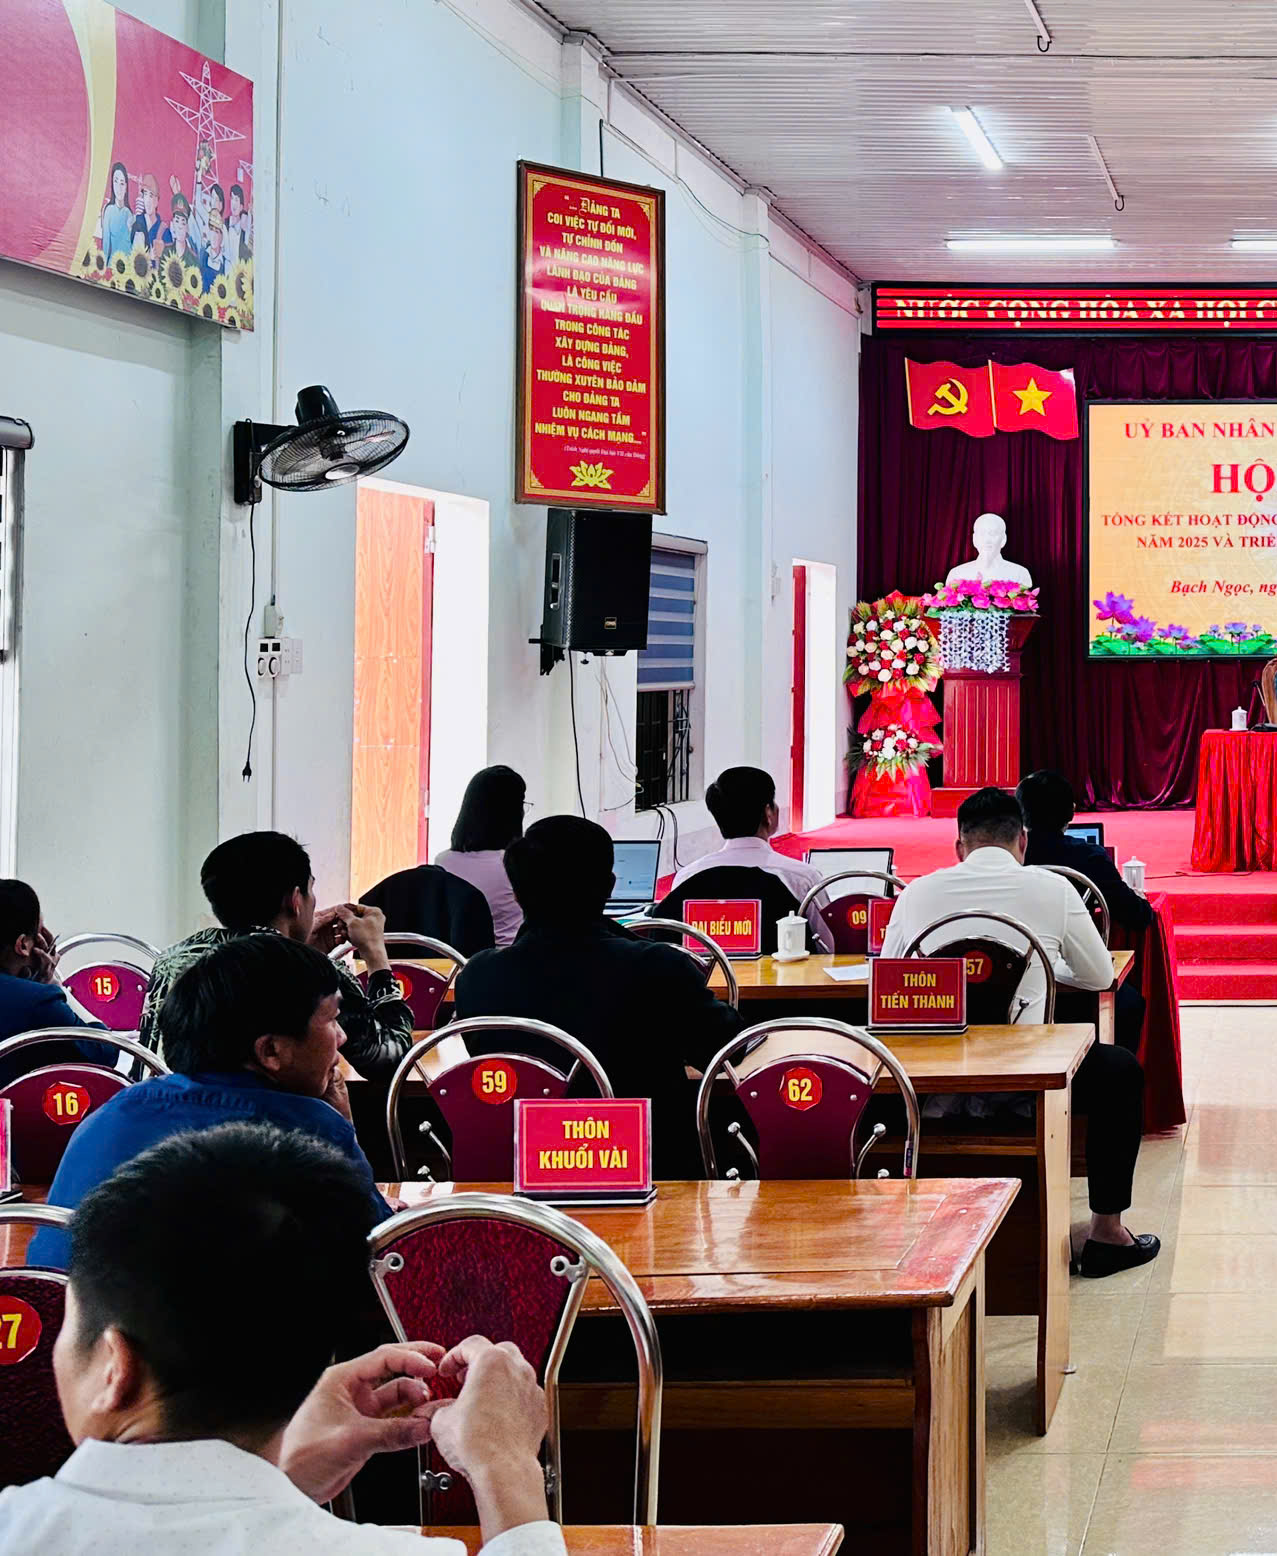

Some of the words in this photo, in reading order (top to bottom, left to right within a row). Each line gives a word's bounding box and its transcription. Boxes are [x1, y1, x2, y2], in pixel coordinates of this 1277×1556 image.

[579, 197, 608, 217] ĐẢNG
[611, 207, 620, 219] TA
[547, 212, 562, 225] COI
[565, 215, 585, 230] VIỆC
[587, 220, 599, 234] TỰ
[600, 221, 615, 235] ĐỔI
[617, 226, 637, 240] MỚI,
[562, 232, 574, 246] TỰ
[575, 234, 602, 249] CHỈNH
[605, 240, 623, 253] ĐỐN
[554, 319, 584, 334] TRONG
[587, 322, 611, 338] CÔNG
[613, 326, 630, 340] TÁC
[555, 336, 573, 349] XÂY
[575, 340, 600, 354] DỰNG
[602, 341, 629, 358] ĐẢNG,
[562, 354, 573, 367] LÀ
[575, 356, 600, 371] CÔNG
[602, 361, 622, 375] VIỆC
[536, 369, 572, 384] THƯỜNG
[575, 374, 604, 389] XUYÊN
[606, 376, 624, 391] BẢO
[626, 379, 646, 394] ĐẢM
[563, 390, 581, 403] CHO
[583, 390, 608, 406] ĐẢNG
[610, 396, 620, 408] TA
[552, 406, 576, 421] LUÔN
[578, 410, 609, 424] NGANG
[612, 411, 631, 426] TẦM
[535, 422, 565, 438] NHIỆM
[567, 426, 579, 440] VỤ
[581, 426, 605, 440] CÁCH
[1162, 422, 1206, 438] BAN
[1212, 417, 1275, 438] NHÂN
[1102, 511, 1146, 527] TỔNG
[1152, 511, 1184, 526] KẾT
[1188, 514, 1233, 528] HOẠT
[1136, 534, 1173, 549] NĂM
[1177, 536, 1209, 549] 2025
[1212, 533, 1234, 548] VÀ
[1170, 580, 1208, 597] Bạch
[1212, 580, 1254, 597] Ngọc,
[710, 914, 731, 936] BIỂU
[852, 910, 867, 925] 09
[967, 958, 984, 975] 57
[95, 977, 112, 996] 15
[903, 971, 936, 987] THÔN
[880, 990, 909, 1009] TIẾN
[913, 993, 955, 1009] THÀNH
[481, 1070, 507, 1093] 59
[787, 1078, 813, 1102] 62
[53, 1092, 79, 1116] 16
[562, 1117, 610, 1139] THÔN
[539, 1143, 593, 1169] KHUỔI
[599, 1146, 628, 1169] VÀI
[0, 1313, 22, 1349] 7
